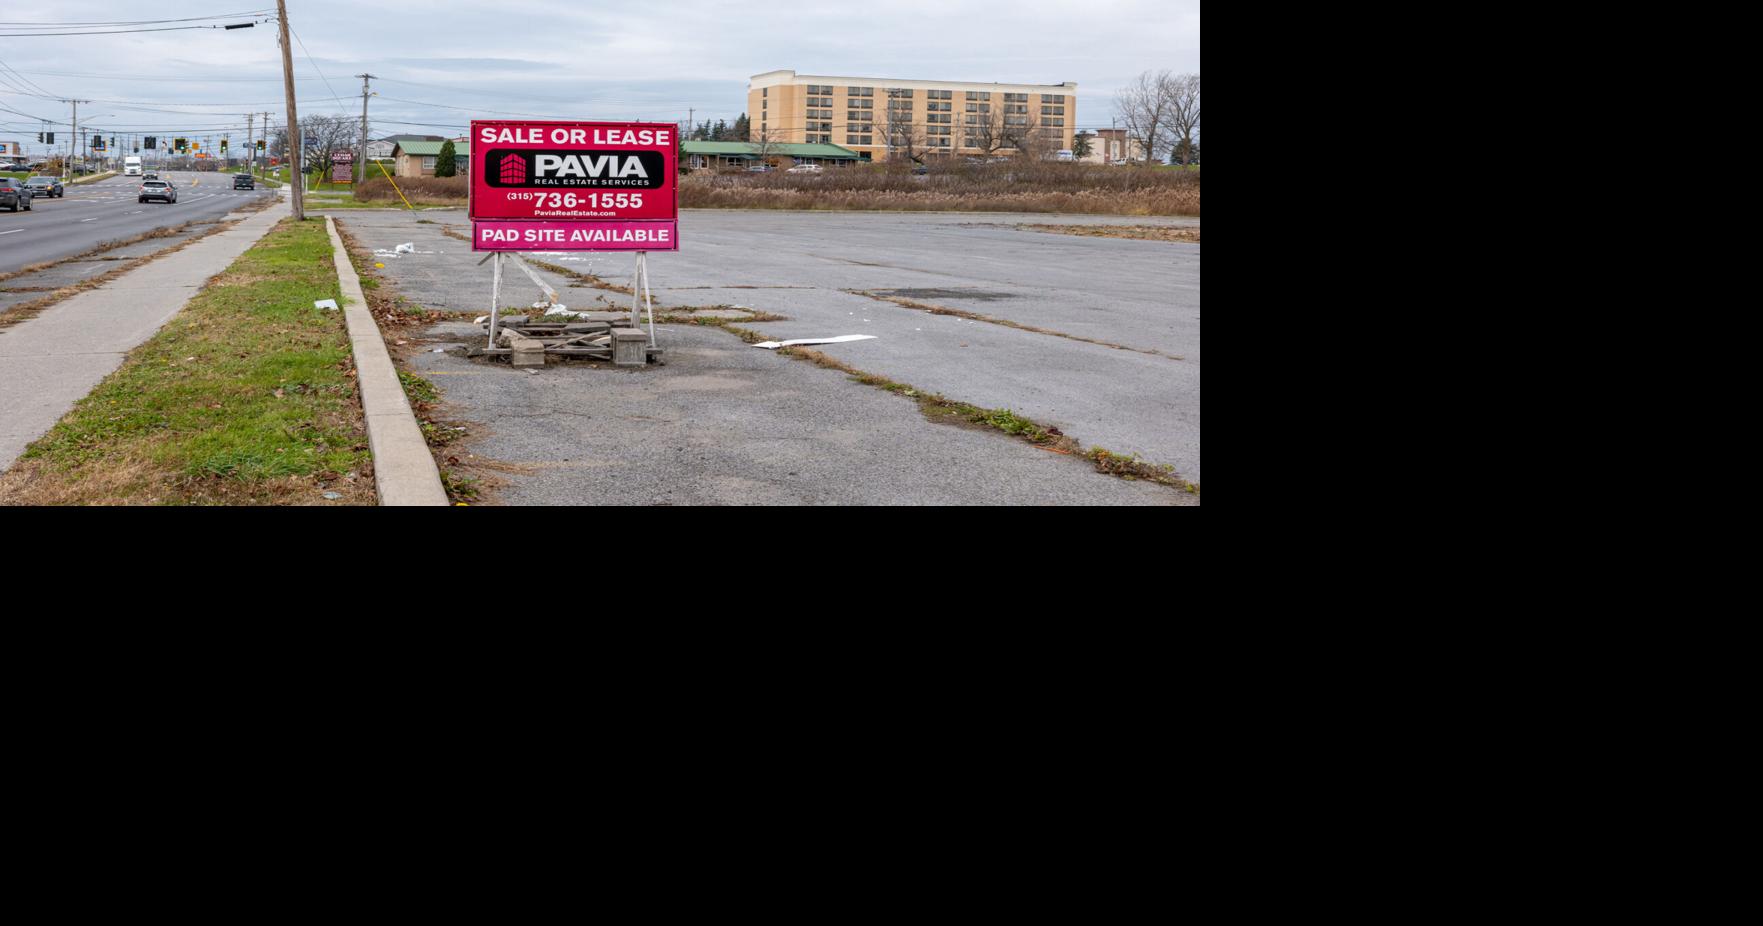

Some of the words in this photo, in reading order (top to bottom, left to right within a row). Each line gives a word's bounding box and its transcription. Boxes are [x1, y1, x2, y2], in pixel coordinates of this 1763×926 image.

[480, 127, 544, 144] SALE
[551, 128, 586, 145] OR
[594, 129, 670, 146] LEASE
[535, 154, 649, 178] PAVIA
[507, 192, 533, 201] (315)
[534, 192, 643, 209] 736-1555
[481, 229, 520, 242] PAD
[524, 229, 566, 242] SITE
[570, 229, 669, 242] AVAILABLE
